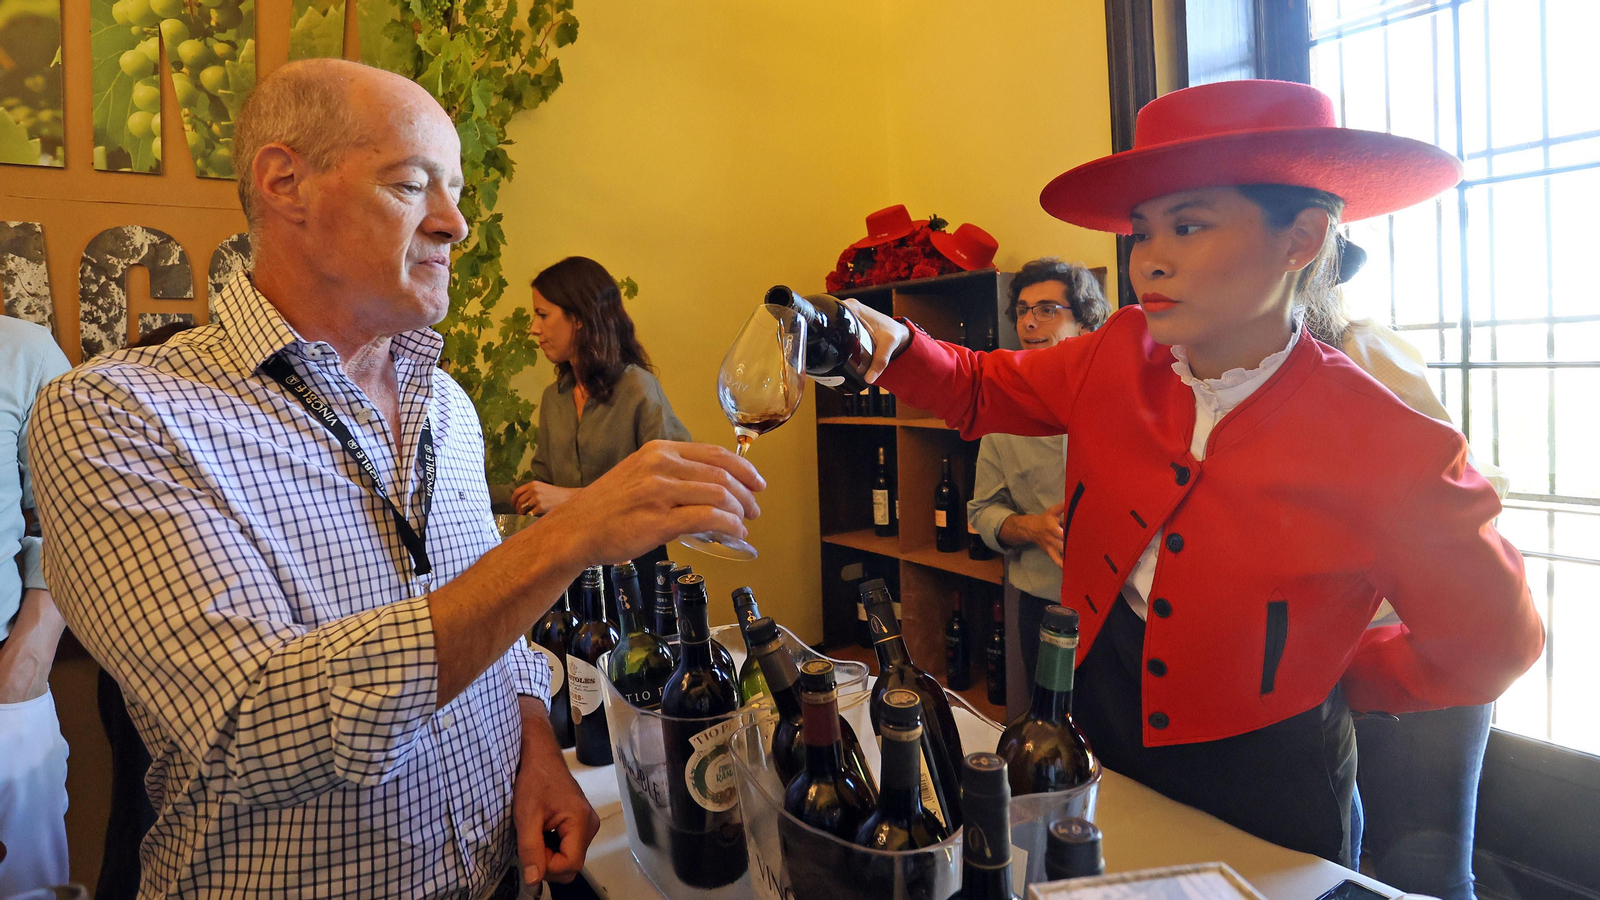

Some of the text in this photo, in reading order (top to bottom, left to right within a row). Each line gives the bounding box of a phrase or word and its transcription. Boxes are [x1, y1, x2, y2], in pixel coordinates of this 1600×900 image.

[294, 383, 338, 427] VINOBLE
[425, 454, 435, 497] VINOBLE
[625, 690, 651, 702] TIO
[693, 728, 719, 745] TIO
